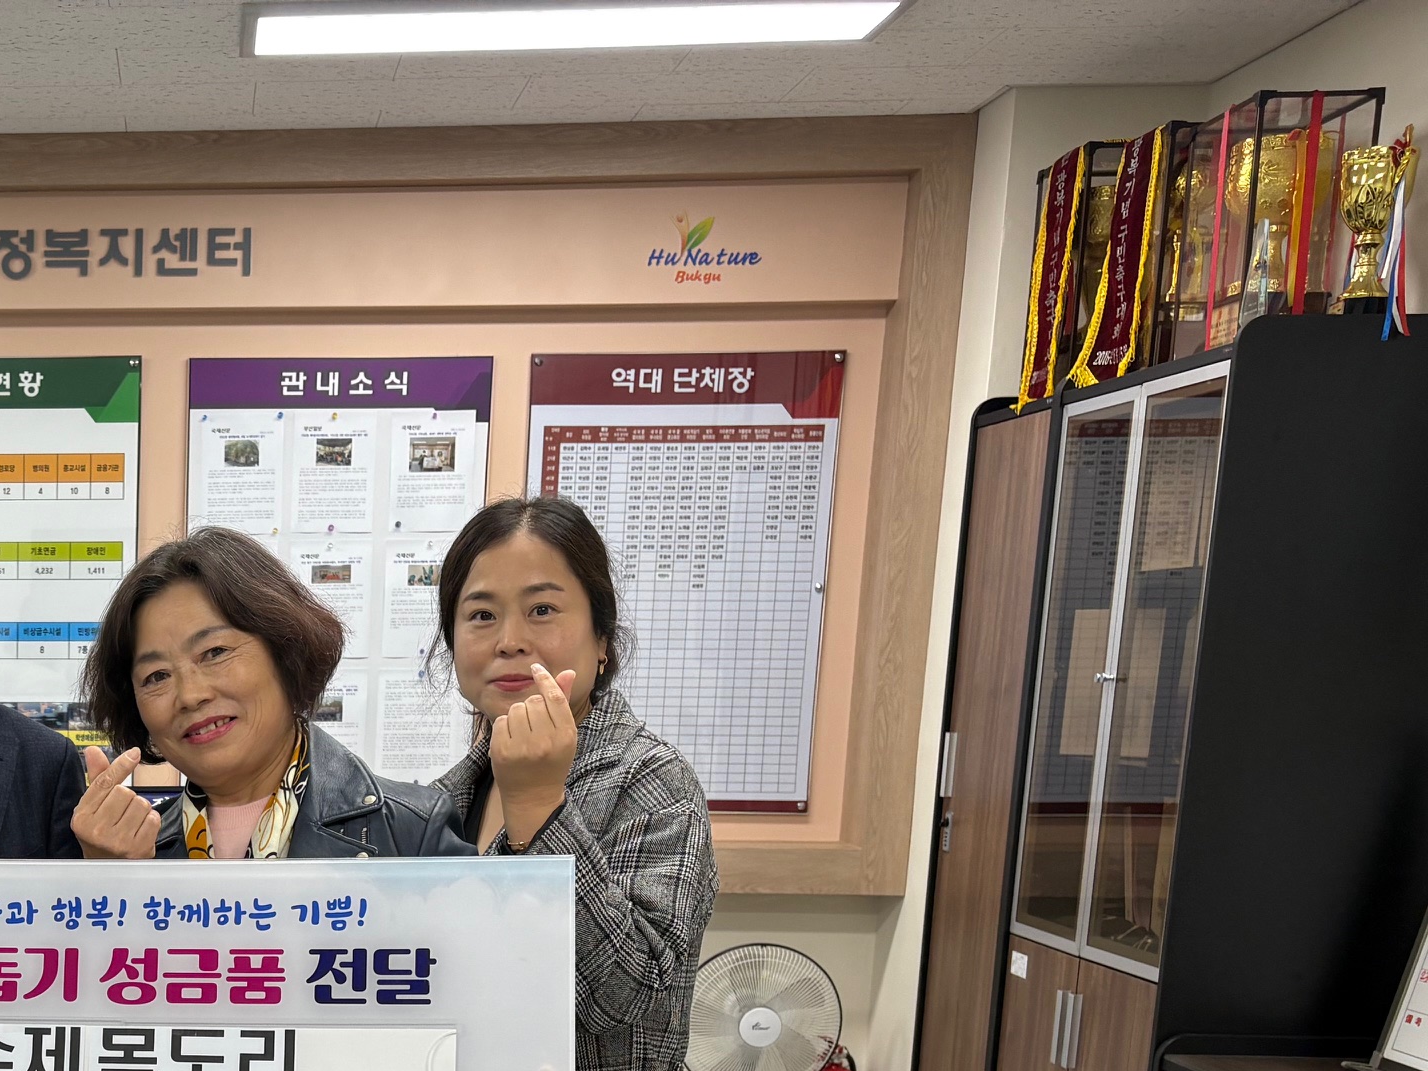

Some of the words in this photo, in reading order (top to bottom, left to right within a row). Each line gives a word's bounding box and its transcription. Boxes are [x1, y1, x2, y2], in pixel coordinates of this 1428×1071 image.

[647, 248, 679, 267] Hu
[683, 248, 762, 267] Nature
[674, 270, 722, 285] Bukgu
[280, 370, 410, 397] 관내소식
[611, 367, 663, 394] 역대
[673, 366, 755, 394] 단체장
[2, 487, 11, 495] 12
[70, 487, 79, 495] 10
[34, 567, 53, 575] 4,232
[87, 567, 105, 575] 1,411
[51, 896, 127, 931] 행복!
[145, 897, 277, 932] 함께하는
[292, 896, 369, 930] 기쁨!
[98, 946, 288, 1006] 성금품
[306, 947, 437, 1006] 전달
